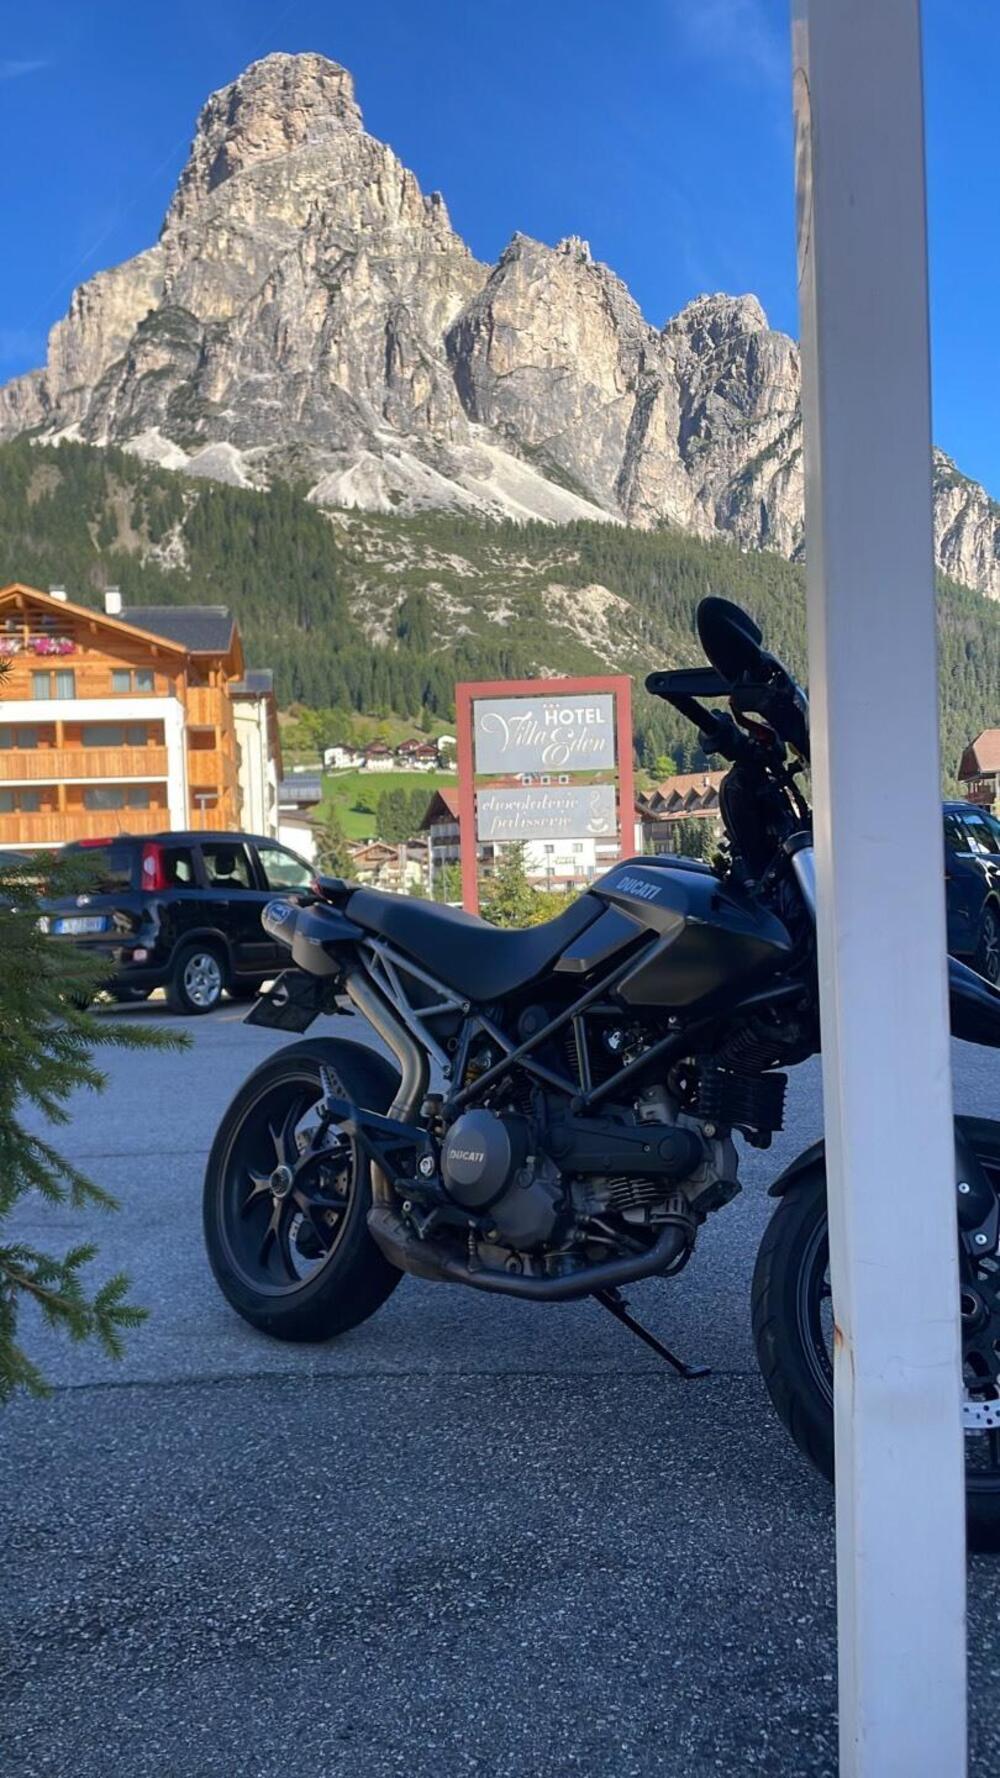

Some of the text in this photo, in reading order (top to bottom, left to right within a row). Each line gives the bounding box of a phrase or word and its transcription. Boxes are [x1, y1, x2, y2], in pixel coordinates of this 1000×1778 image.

[545, 709, 605, 725] HOTEL
[481, 711, 606, 766] Villa Eden
[616, 877, 662, 899] DUCATI
[448, 1150, 484, 1162] DUCATI
